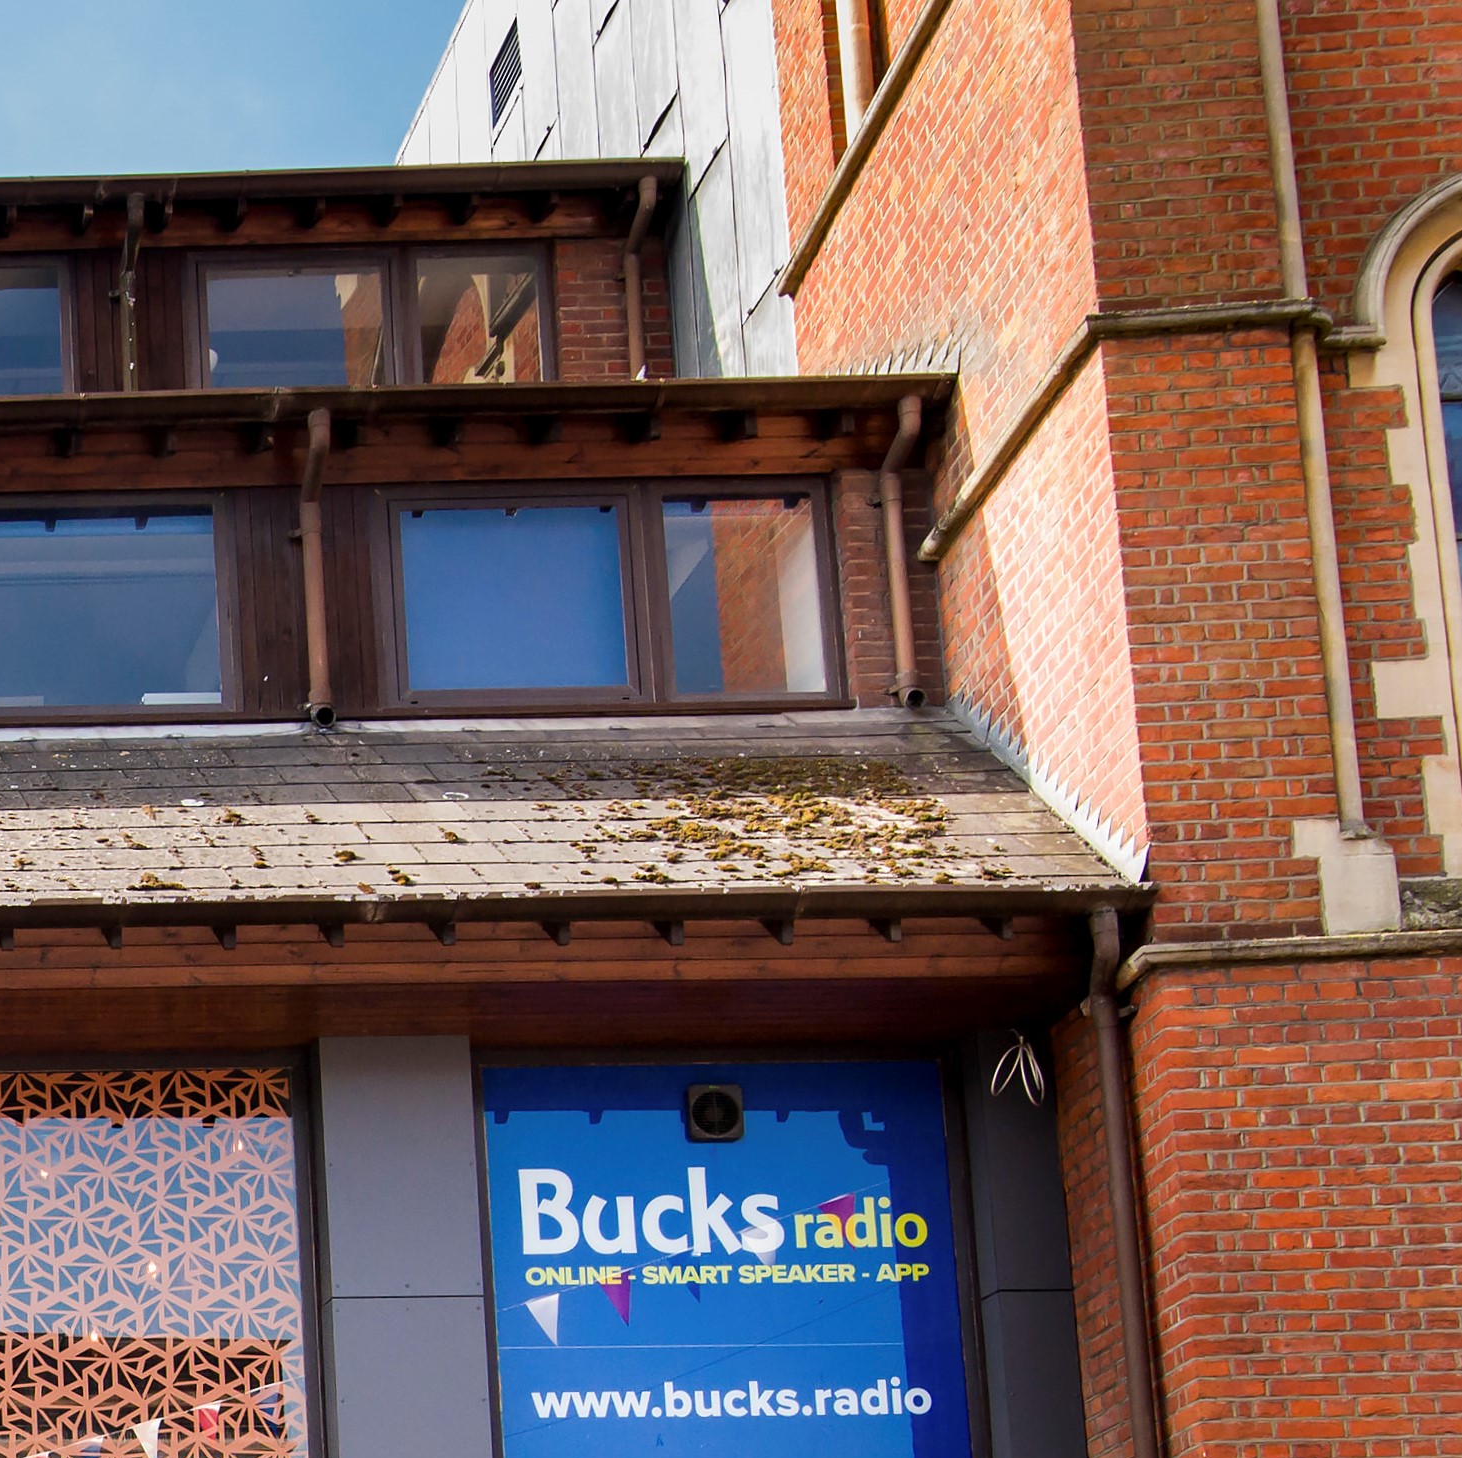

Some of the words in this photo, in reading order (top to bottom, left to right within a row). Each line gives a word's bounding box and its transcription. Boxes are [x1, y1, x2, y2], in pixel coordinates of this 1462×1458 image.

[517, 1166, 785, 1257] Bucks
[795, 1197, 929, 1250] radio
[525, 1265, 623, 1287] ONLINE
[642, 1264, 732, 1286] SMART
[737, 1263, 856, 1285] SPEAKER
[876, 1263, 930, 1284] APP
[531, 1375, 933, 1420] www.bucks.radio
